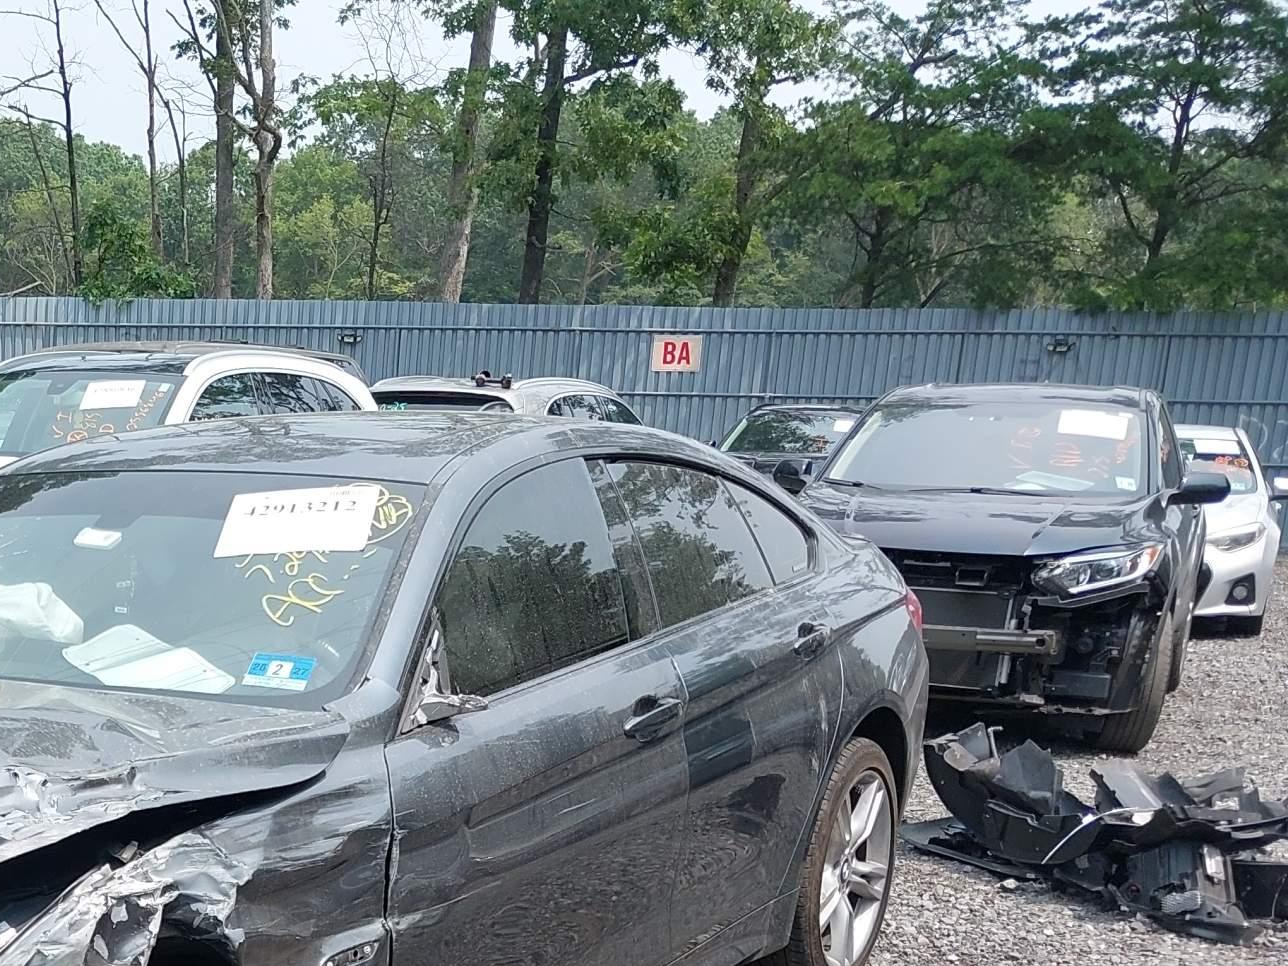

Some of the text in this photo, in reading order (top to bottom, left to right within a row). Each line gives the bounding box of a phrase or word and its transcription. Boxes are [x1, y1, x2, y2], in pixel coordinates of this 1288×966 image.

[662, 341, 691, 365] BA
[244, 499, 358, 517] 42913212
[271, 663, 284, 676] 2
[293, 666, 309, 676] 27
